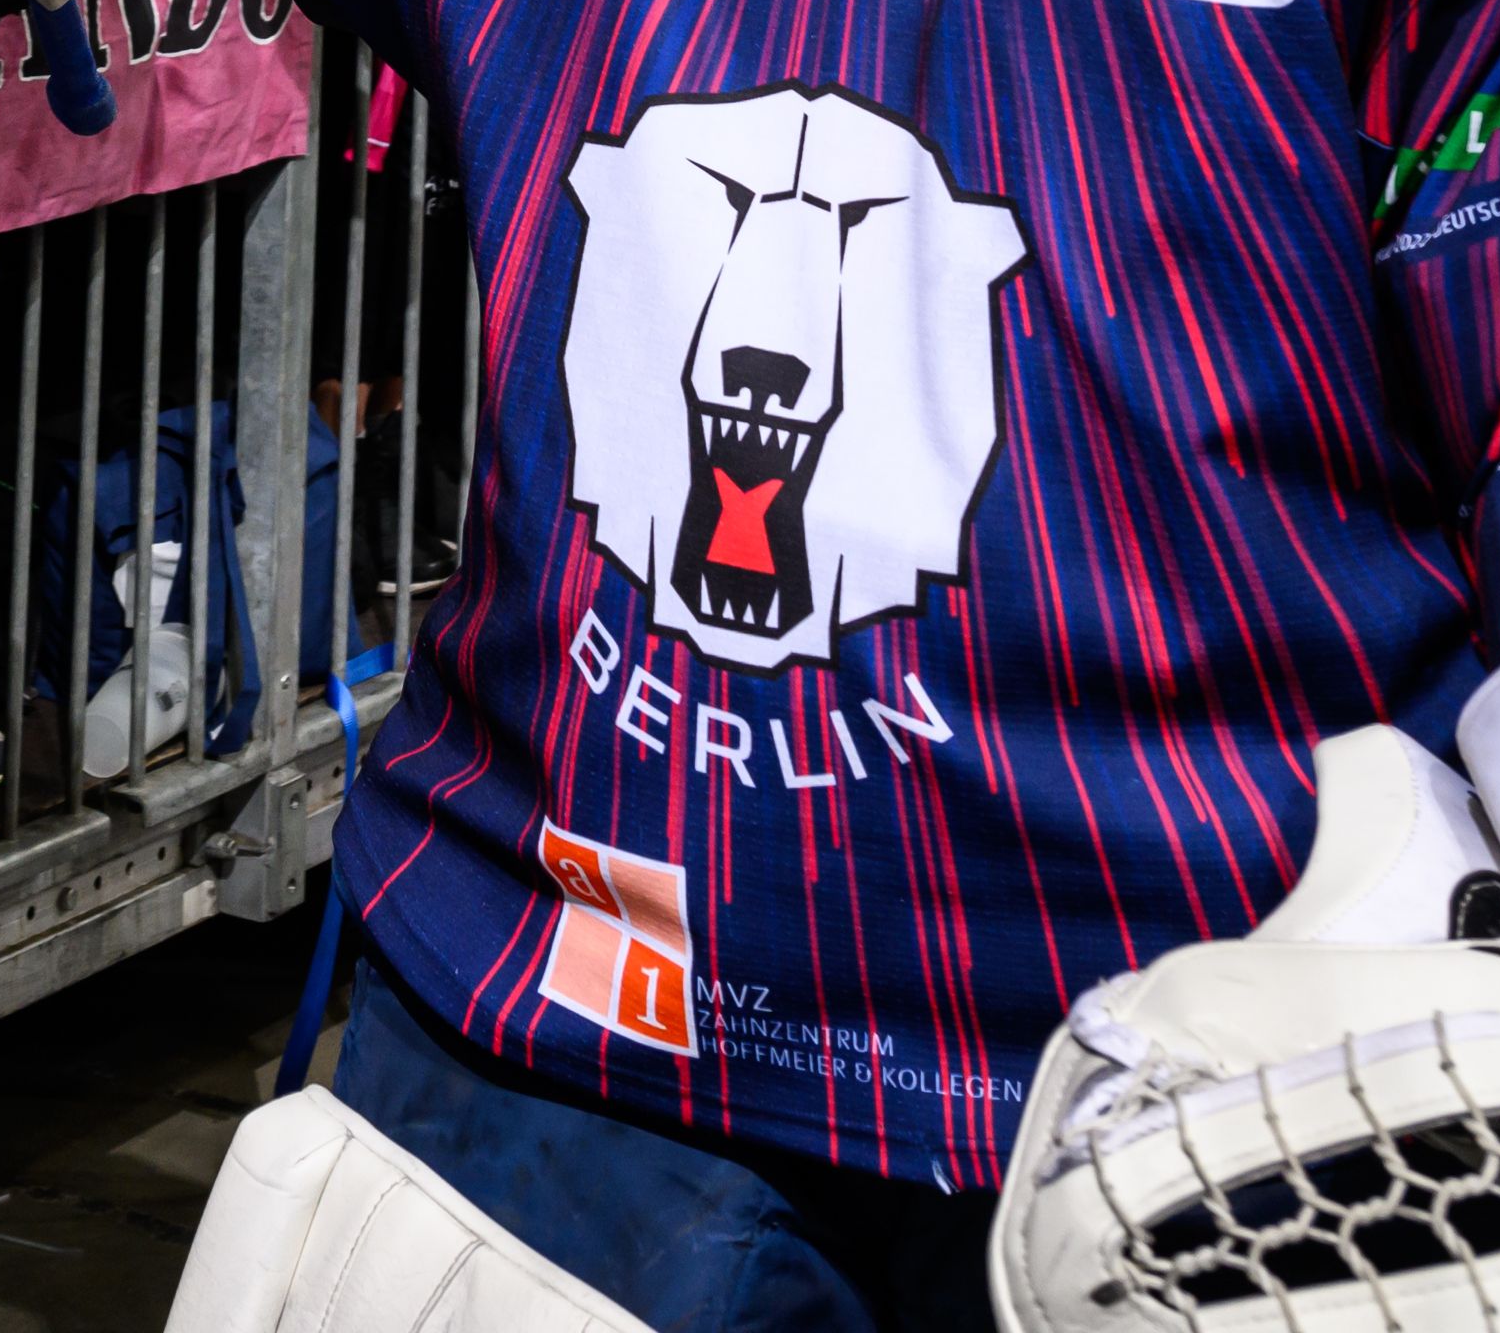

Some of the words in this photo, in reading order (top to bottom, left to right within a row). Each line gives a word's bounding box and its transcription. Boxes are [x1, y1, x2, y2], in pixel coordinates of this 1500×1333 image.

[568, 607, 955, 791] BERLIN
[557, 853, 608, 907] a
[697, 976, 775, 1015] MVZ
[696, 1008, 897, 1059] ZAHNZENTRUM
[701, 1035, 849, 1080] HOFFMEIER
[853, 1059, 874, 1085] &
[880, 1066, 1025, 1105] KOLLEGEN
